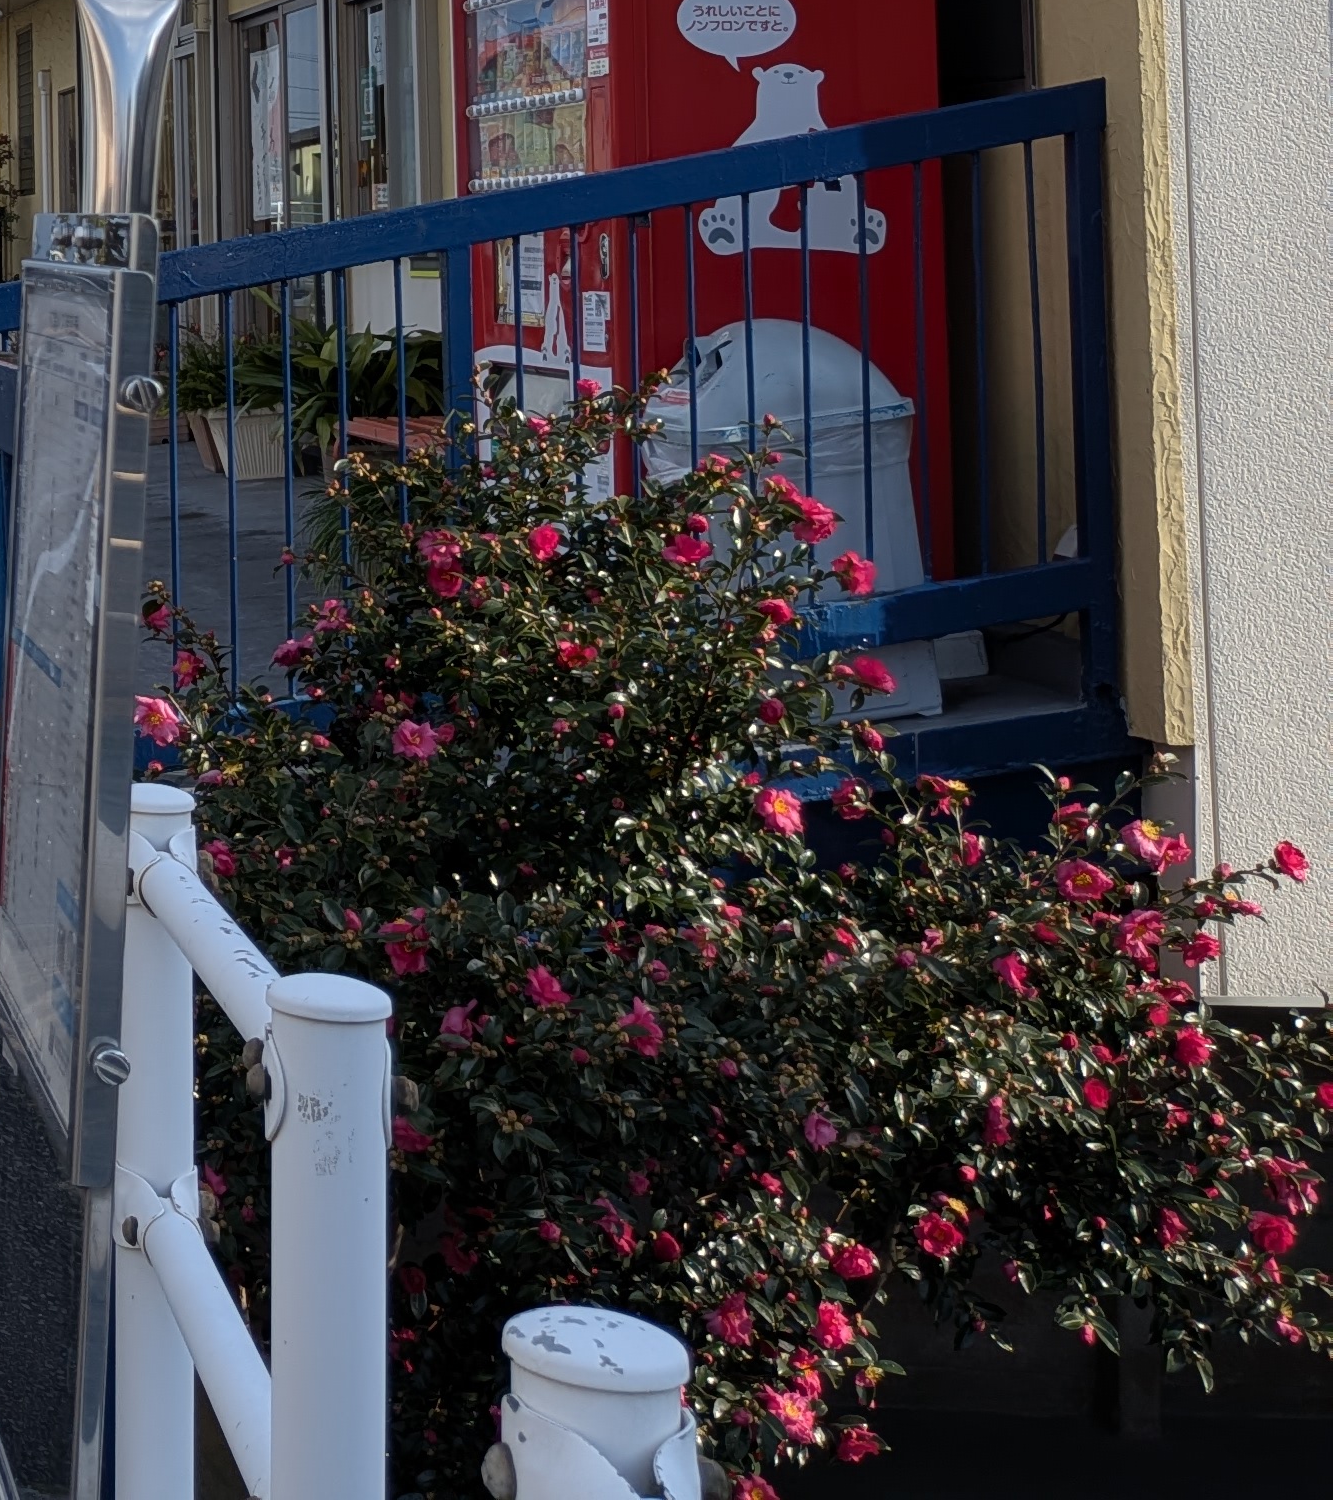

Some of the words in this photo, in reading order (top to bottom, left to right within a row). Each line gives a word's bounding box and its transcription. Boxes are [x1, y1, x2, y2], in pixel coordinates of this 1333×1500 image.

[692, 5, 781, 18] うれしいことに
[685, 20, 789, 32] ノンフロンですと。
